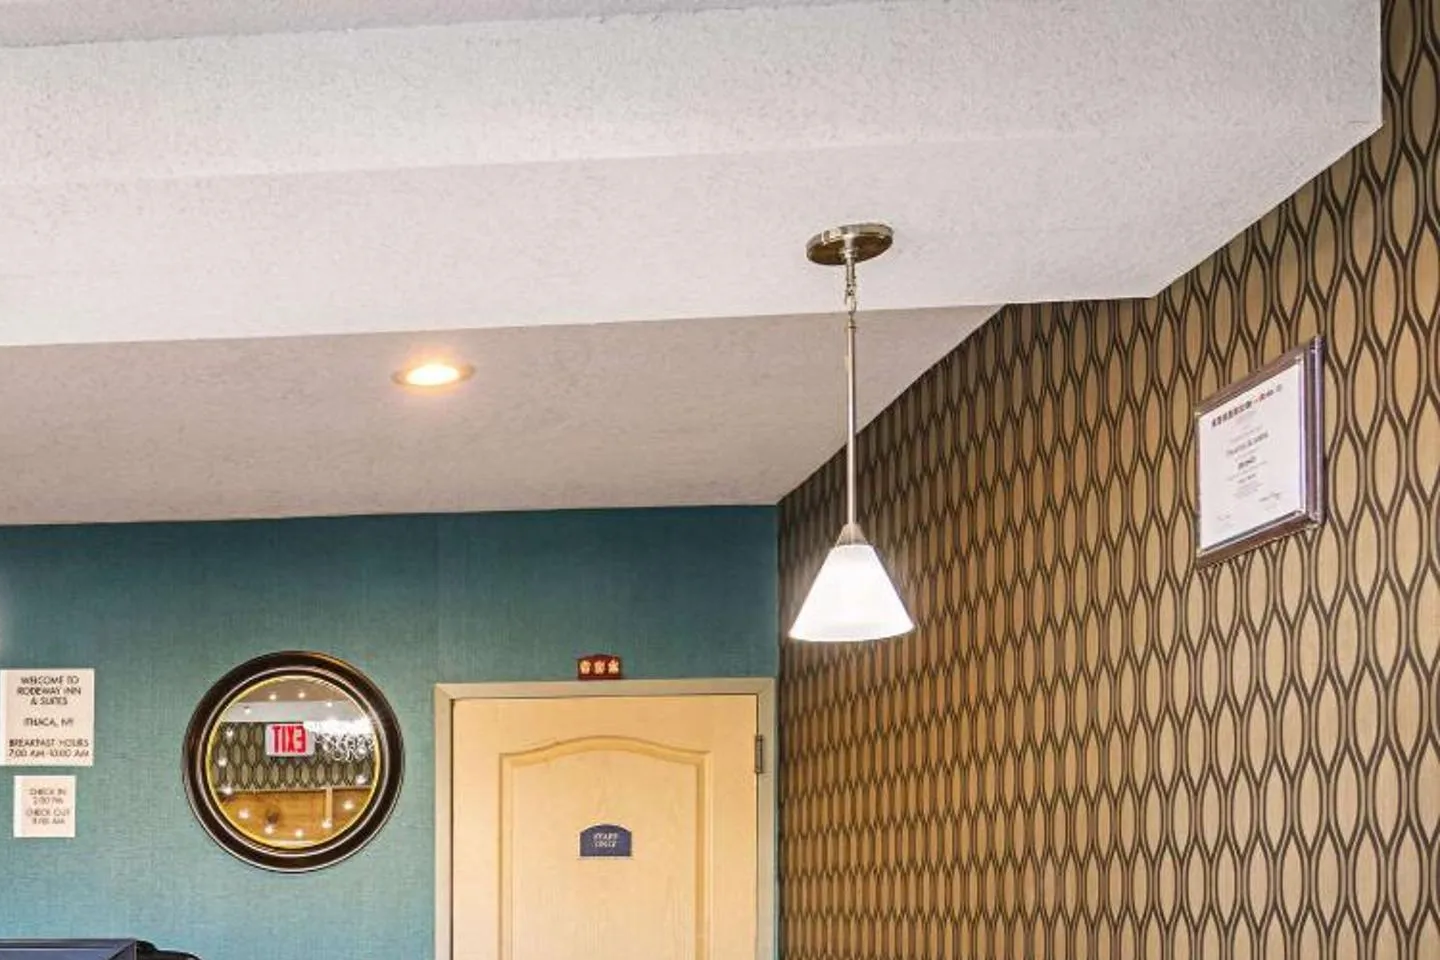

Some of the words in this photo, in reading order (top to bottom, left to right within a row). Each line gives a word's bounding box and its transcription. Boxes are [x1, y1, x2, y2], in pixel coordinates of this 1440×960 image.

[20, 675, 64, 685] WELCOME
[16, 686, 61, 696] RODEWAY
[9, 738, 56, 747] BREAKFAST
[59, 738, 89, 747] HOURS
